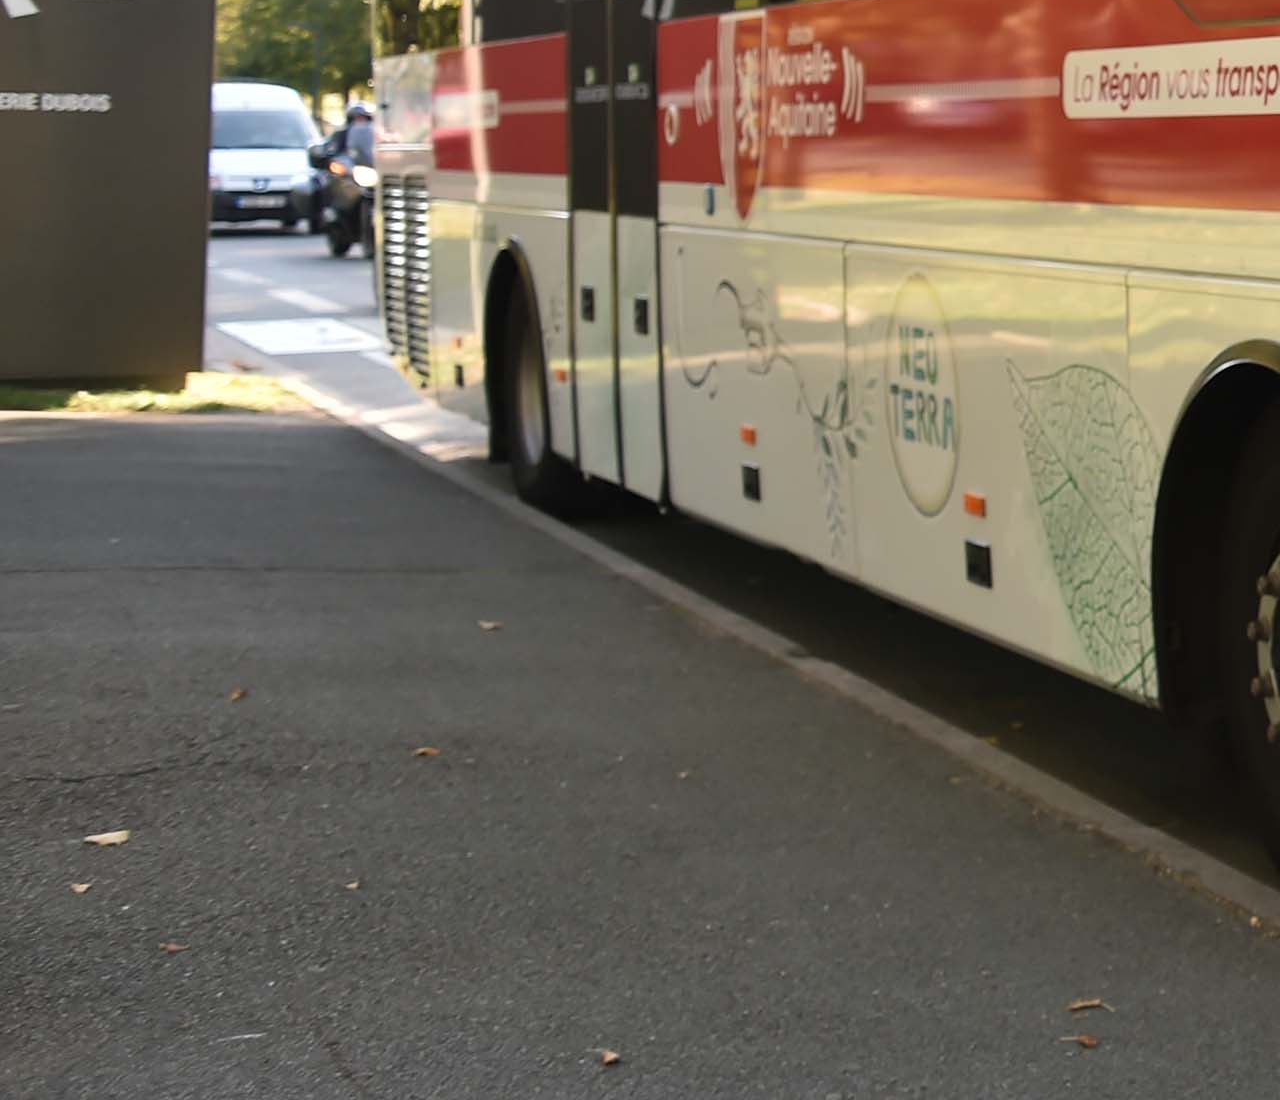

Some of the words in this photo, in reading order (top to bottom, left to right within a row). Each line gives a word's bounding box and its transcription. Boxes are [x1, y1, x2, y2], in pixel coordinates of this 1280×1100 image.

[1074, 66, 1094, 103] La
[1099, 62, 1160, 111] Région
[1166, 68, 1211, 99] vous
[767, 93, 836, 148] Aquitaine
[890, 383, 954, 451] TERRA
